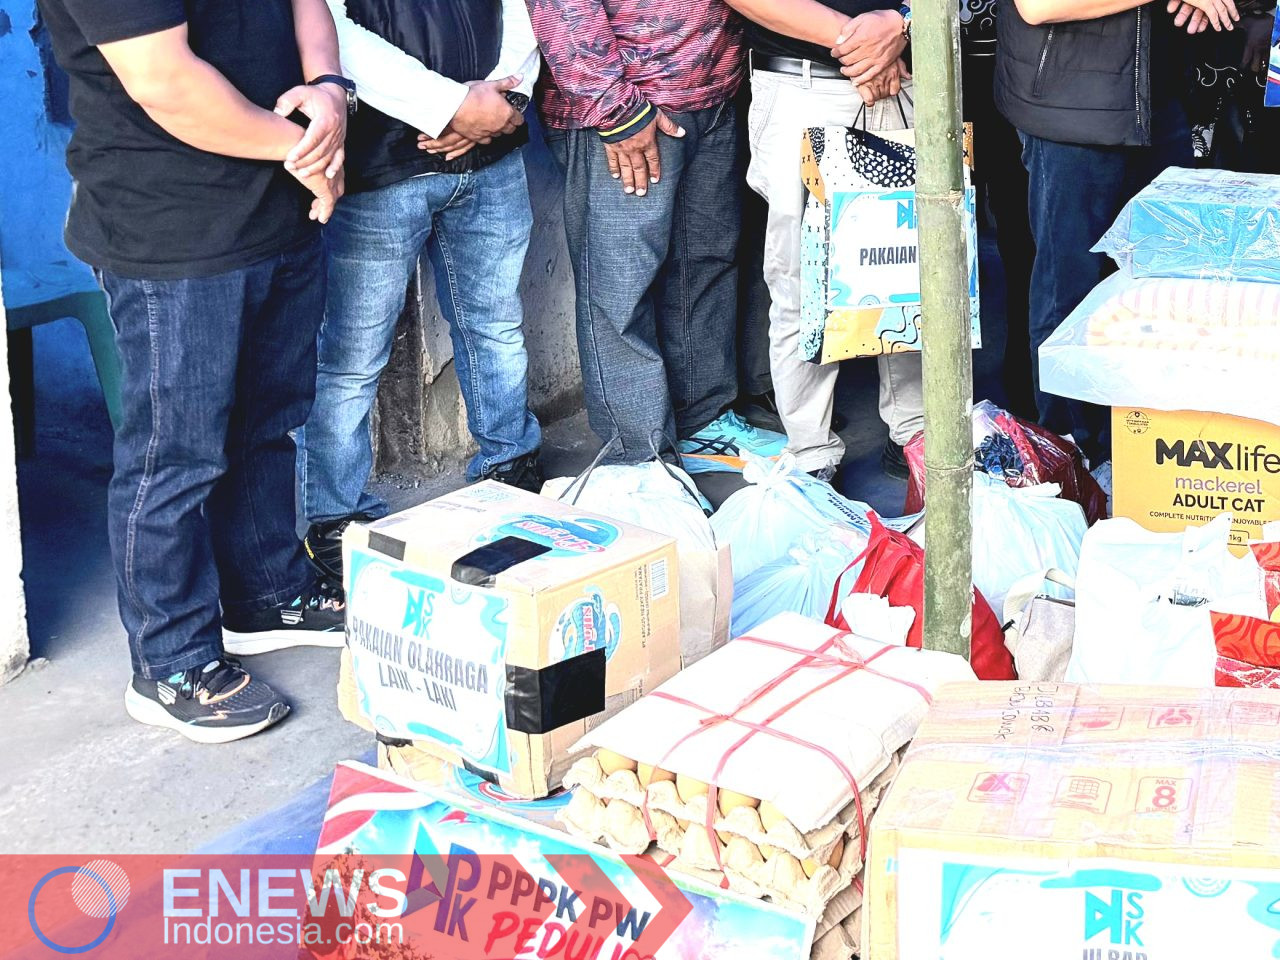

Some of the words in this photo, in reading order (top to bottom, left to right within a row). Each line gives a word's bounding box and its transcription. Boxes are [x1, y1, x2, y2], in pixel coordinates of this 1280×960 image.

[859, 246, 917, 266] PAKAIAN
[1155, 438, 1280, 474] MAXlife
[1175, 476, 1263, 495] mackerel
[1172, 493, 1229, 510] ADULT
[1231, 497, 1266, 513] CAT
[1149, 510, 1185, 520] COMPLETE
[353, 615, 404, 665] PAKAIAN
[407, 641, 489, 694] OLAHRAGA
[423, 678, 458, 712] LAKI
[1152, 786, 1177, 808] 8
[486, 861, 582, 923] PPPK
[588, 895, 652, 942] PW
